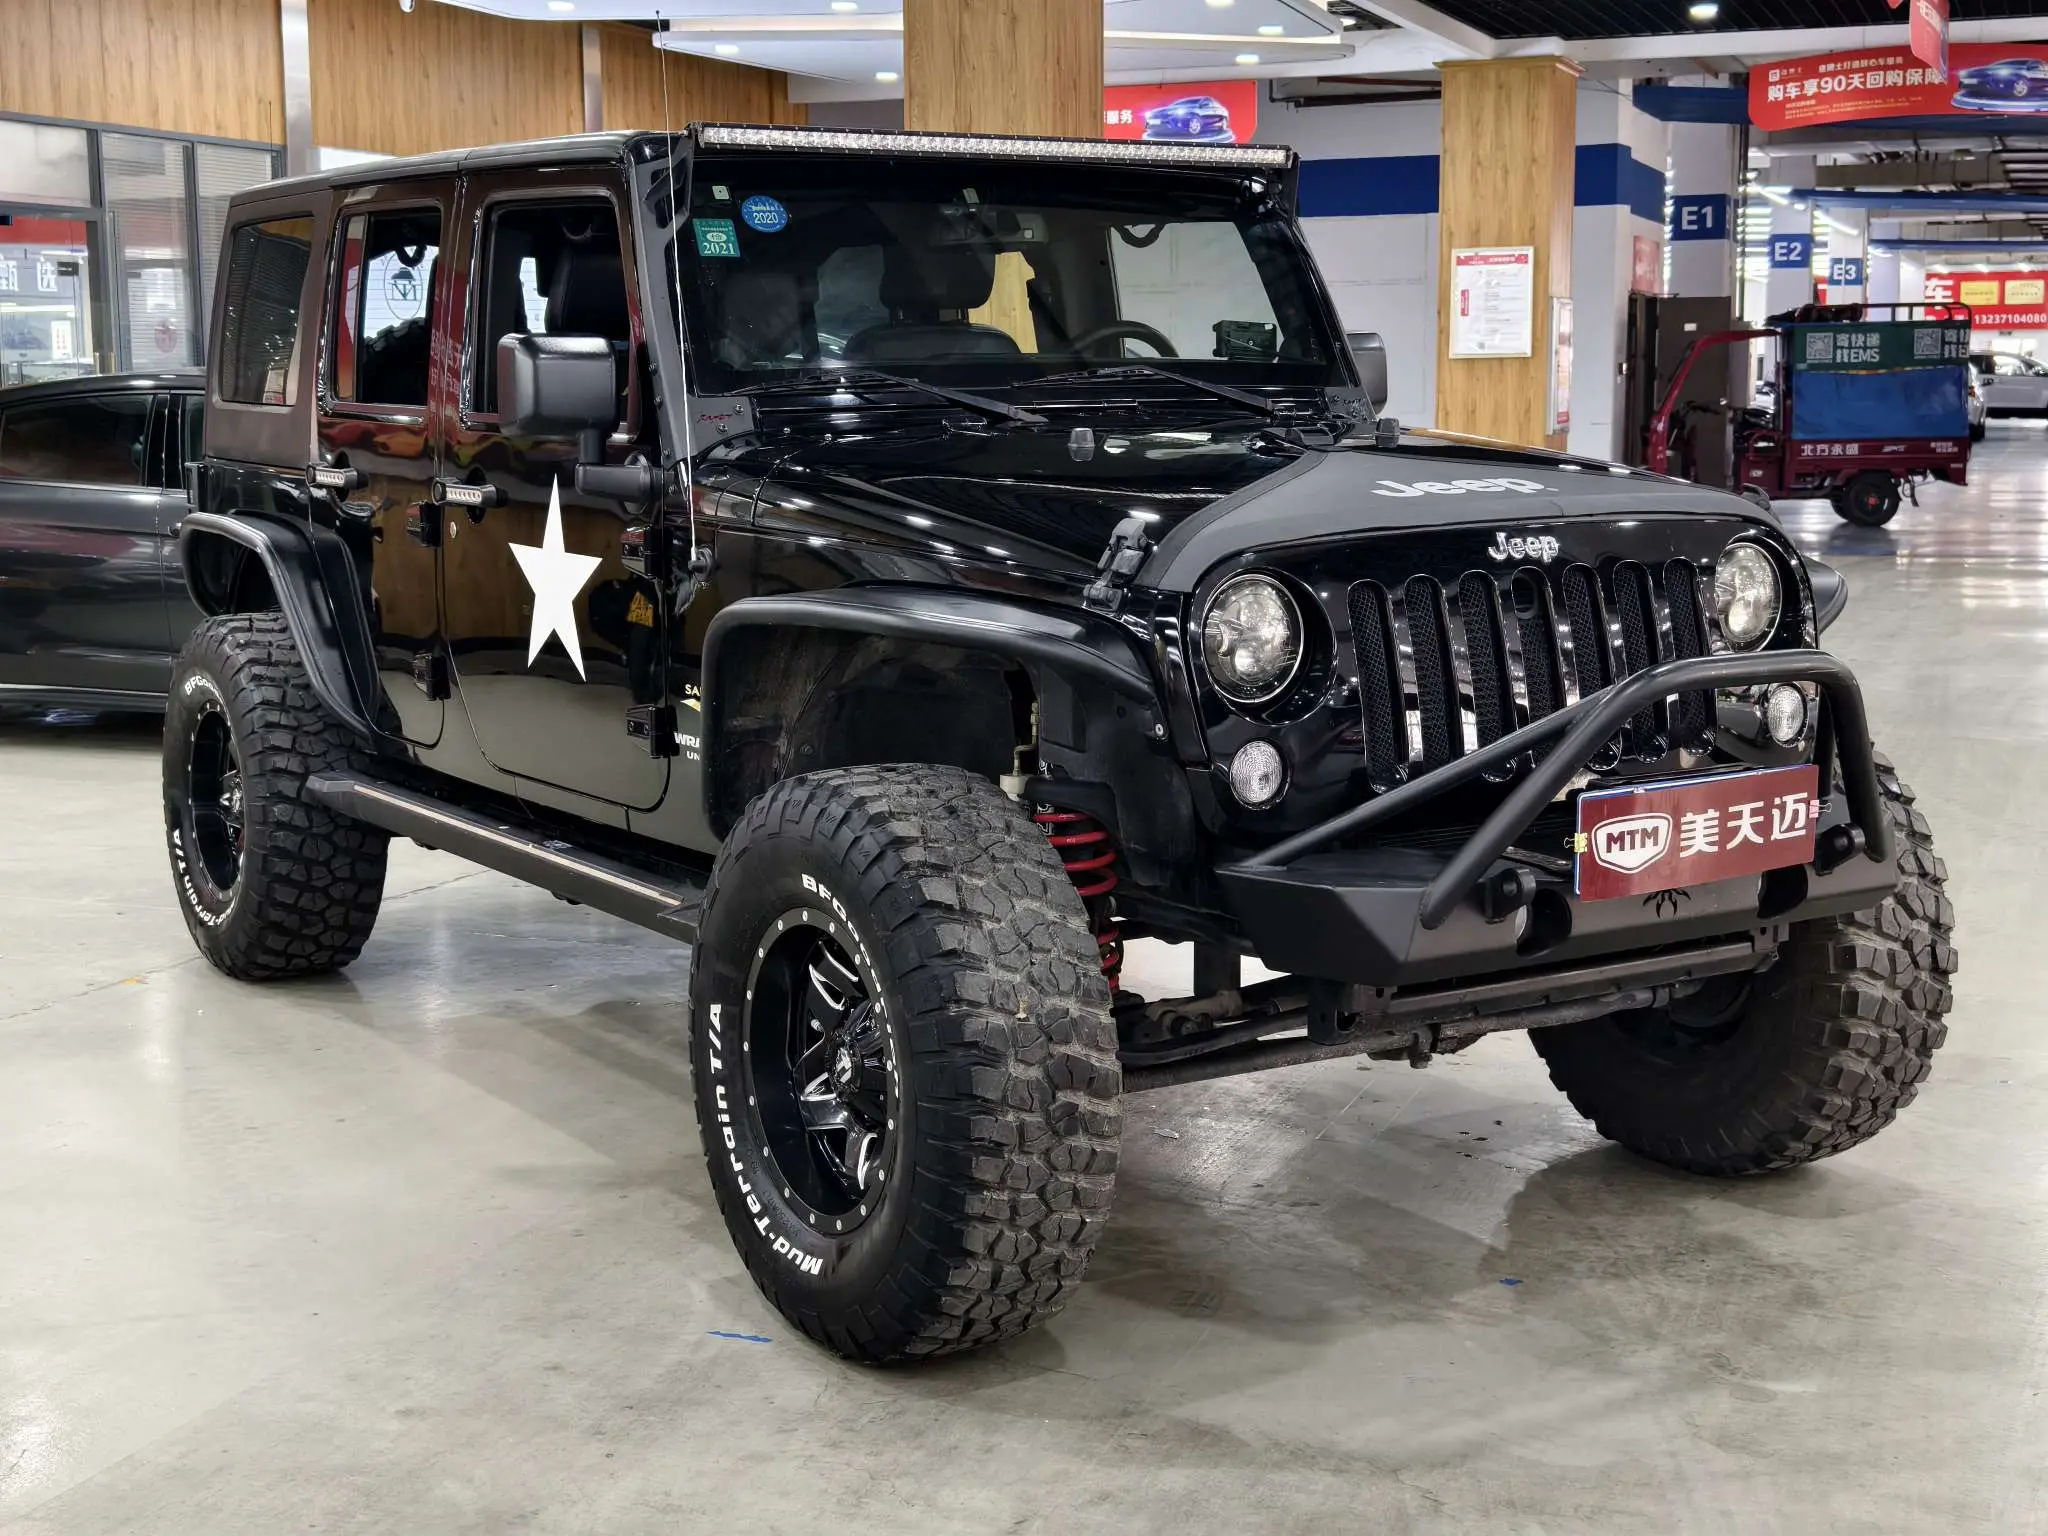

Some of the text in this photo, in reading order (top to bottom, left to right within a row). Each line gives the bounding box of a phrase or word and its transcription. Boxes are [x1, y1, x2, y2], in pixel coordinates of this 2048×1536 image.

[1104, 109, 1133, 125] 服务
[752, 212, 779, 224] 2020
[1681, 206, 1713, 231] E1
[703, 242, 736, 255] 2021
[1774, 242, 1802, 261] E2
[1833, 263, 1857, 280] E3
[1974, 312, 2047, 325] 13237104080
[1371, 478, 1545, 498] Jeep
[1488, 532, 1561, 563] Jeep
[684, 683, 702, 696] SA
[1679, 792, 1808, 858] 美天迈
[1606, 826, 1659, 853] MTM
[708, 1003, 723, 1074] T/A
[715, 1085, 824, 1276] Mud-Terrain
